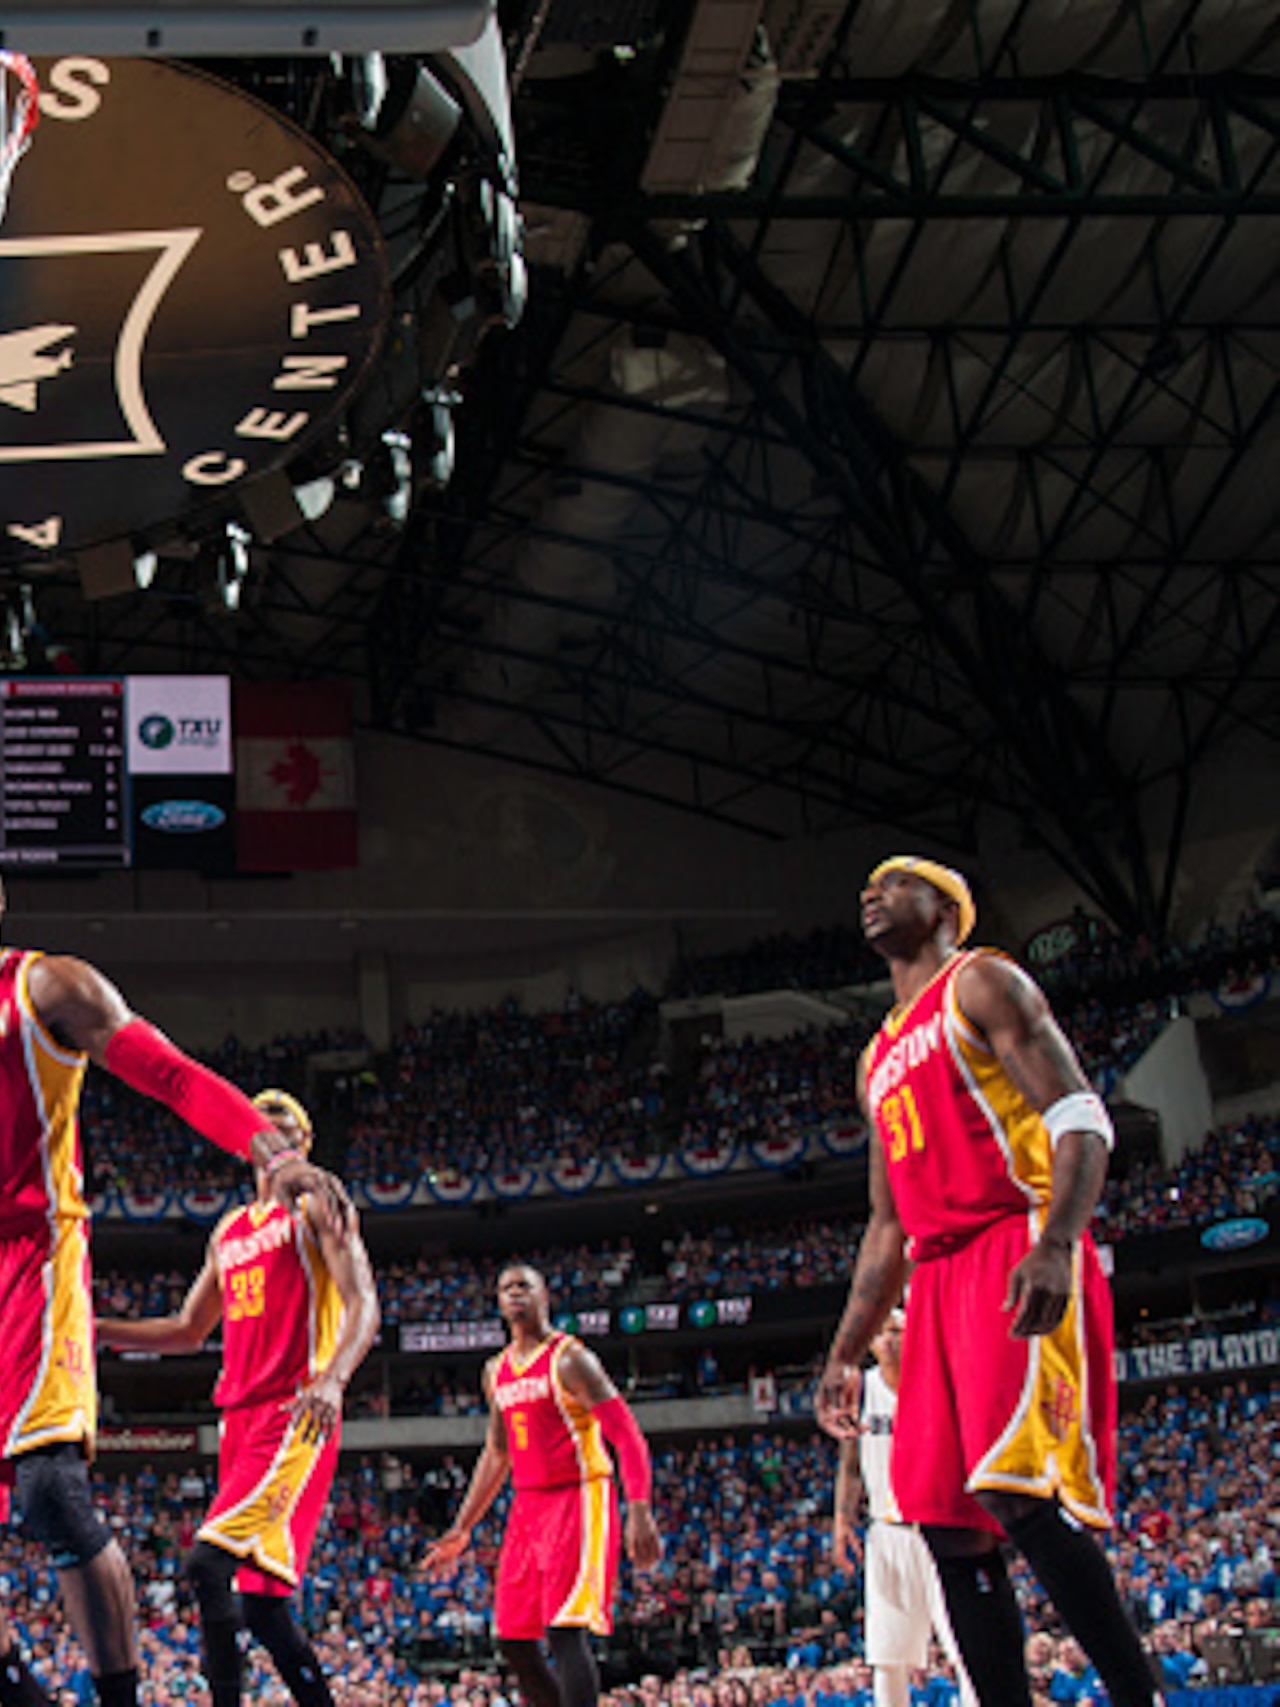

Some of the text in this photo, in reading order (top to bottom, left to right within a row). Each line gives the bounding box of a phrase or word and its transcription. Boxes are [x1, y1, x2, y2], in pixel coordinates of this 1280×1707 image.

[881, 1084, 924, 1163] 31
[227, 1265, 266, 1321] 33
[1131, 1342, 1187, 1378] THE
[511, 1411, 528, 1451] 5
